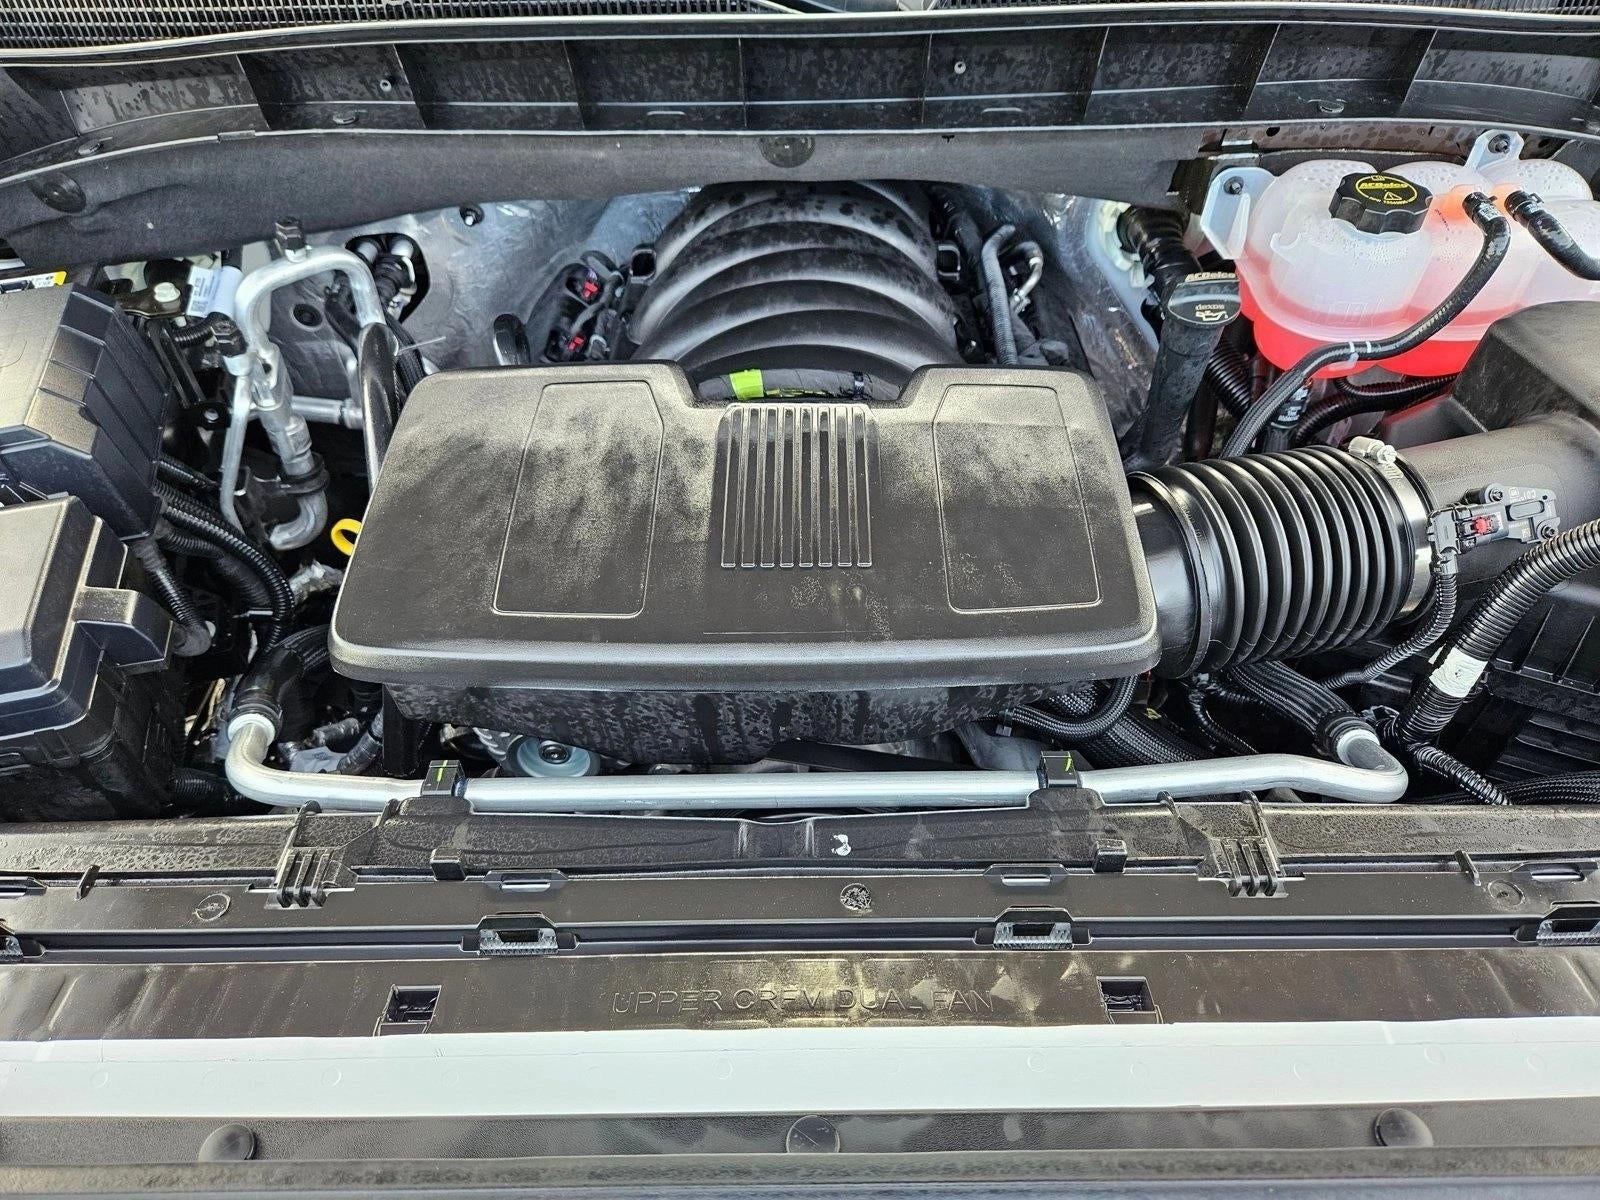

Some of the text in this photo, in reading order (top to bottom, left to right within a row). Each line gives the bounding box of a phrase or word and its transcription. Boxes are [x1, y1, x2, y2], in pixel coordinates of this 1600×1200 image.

[1358, 182, 1409, 190] ACDelco
[1184, 271, 1236, 283] ACDelco
[612, 989, 722, 1013] UPPER
[931, 989, 994, 1013] FAN
